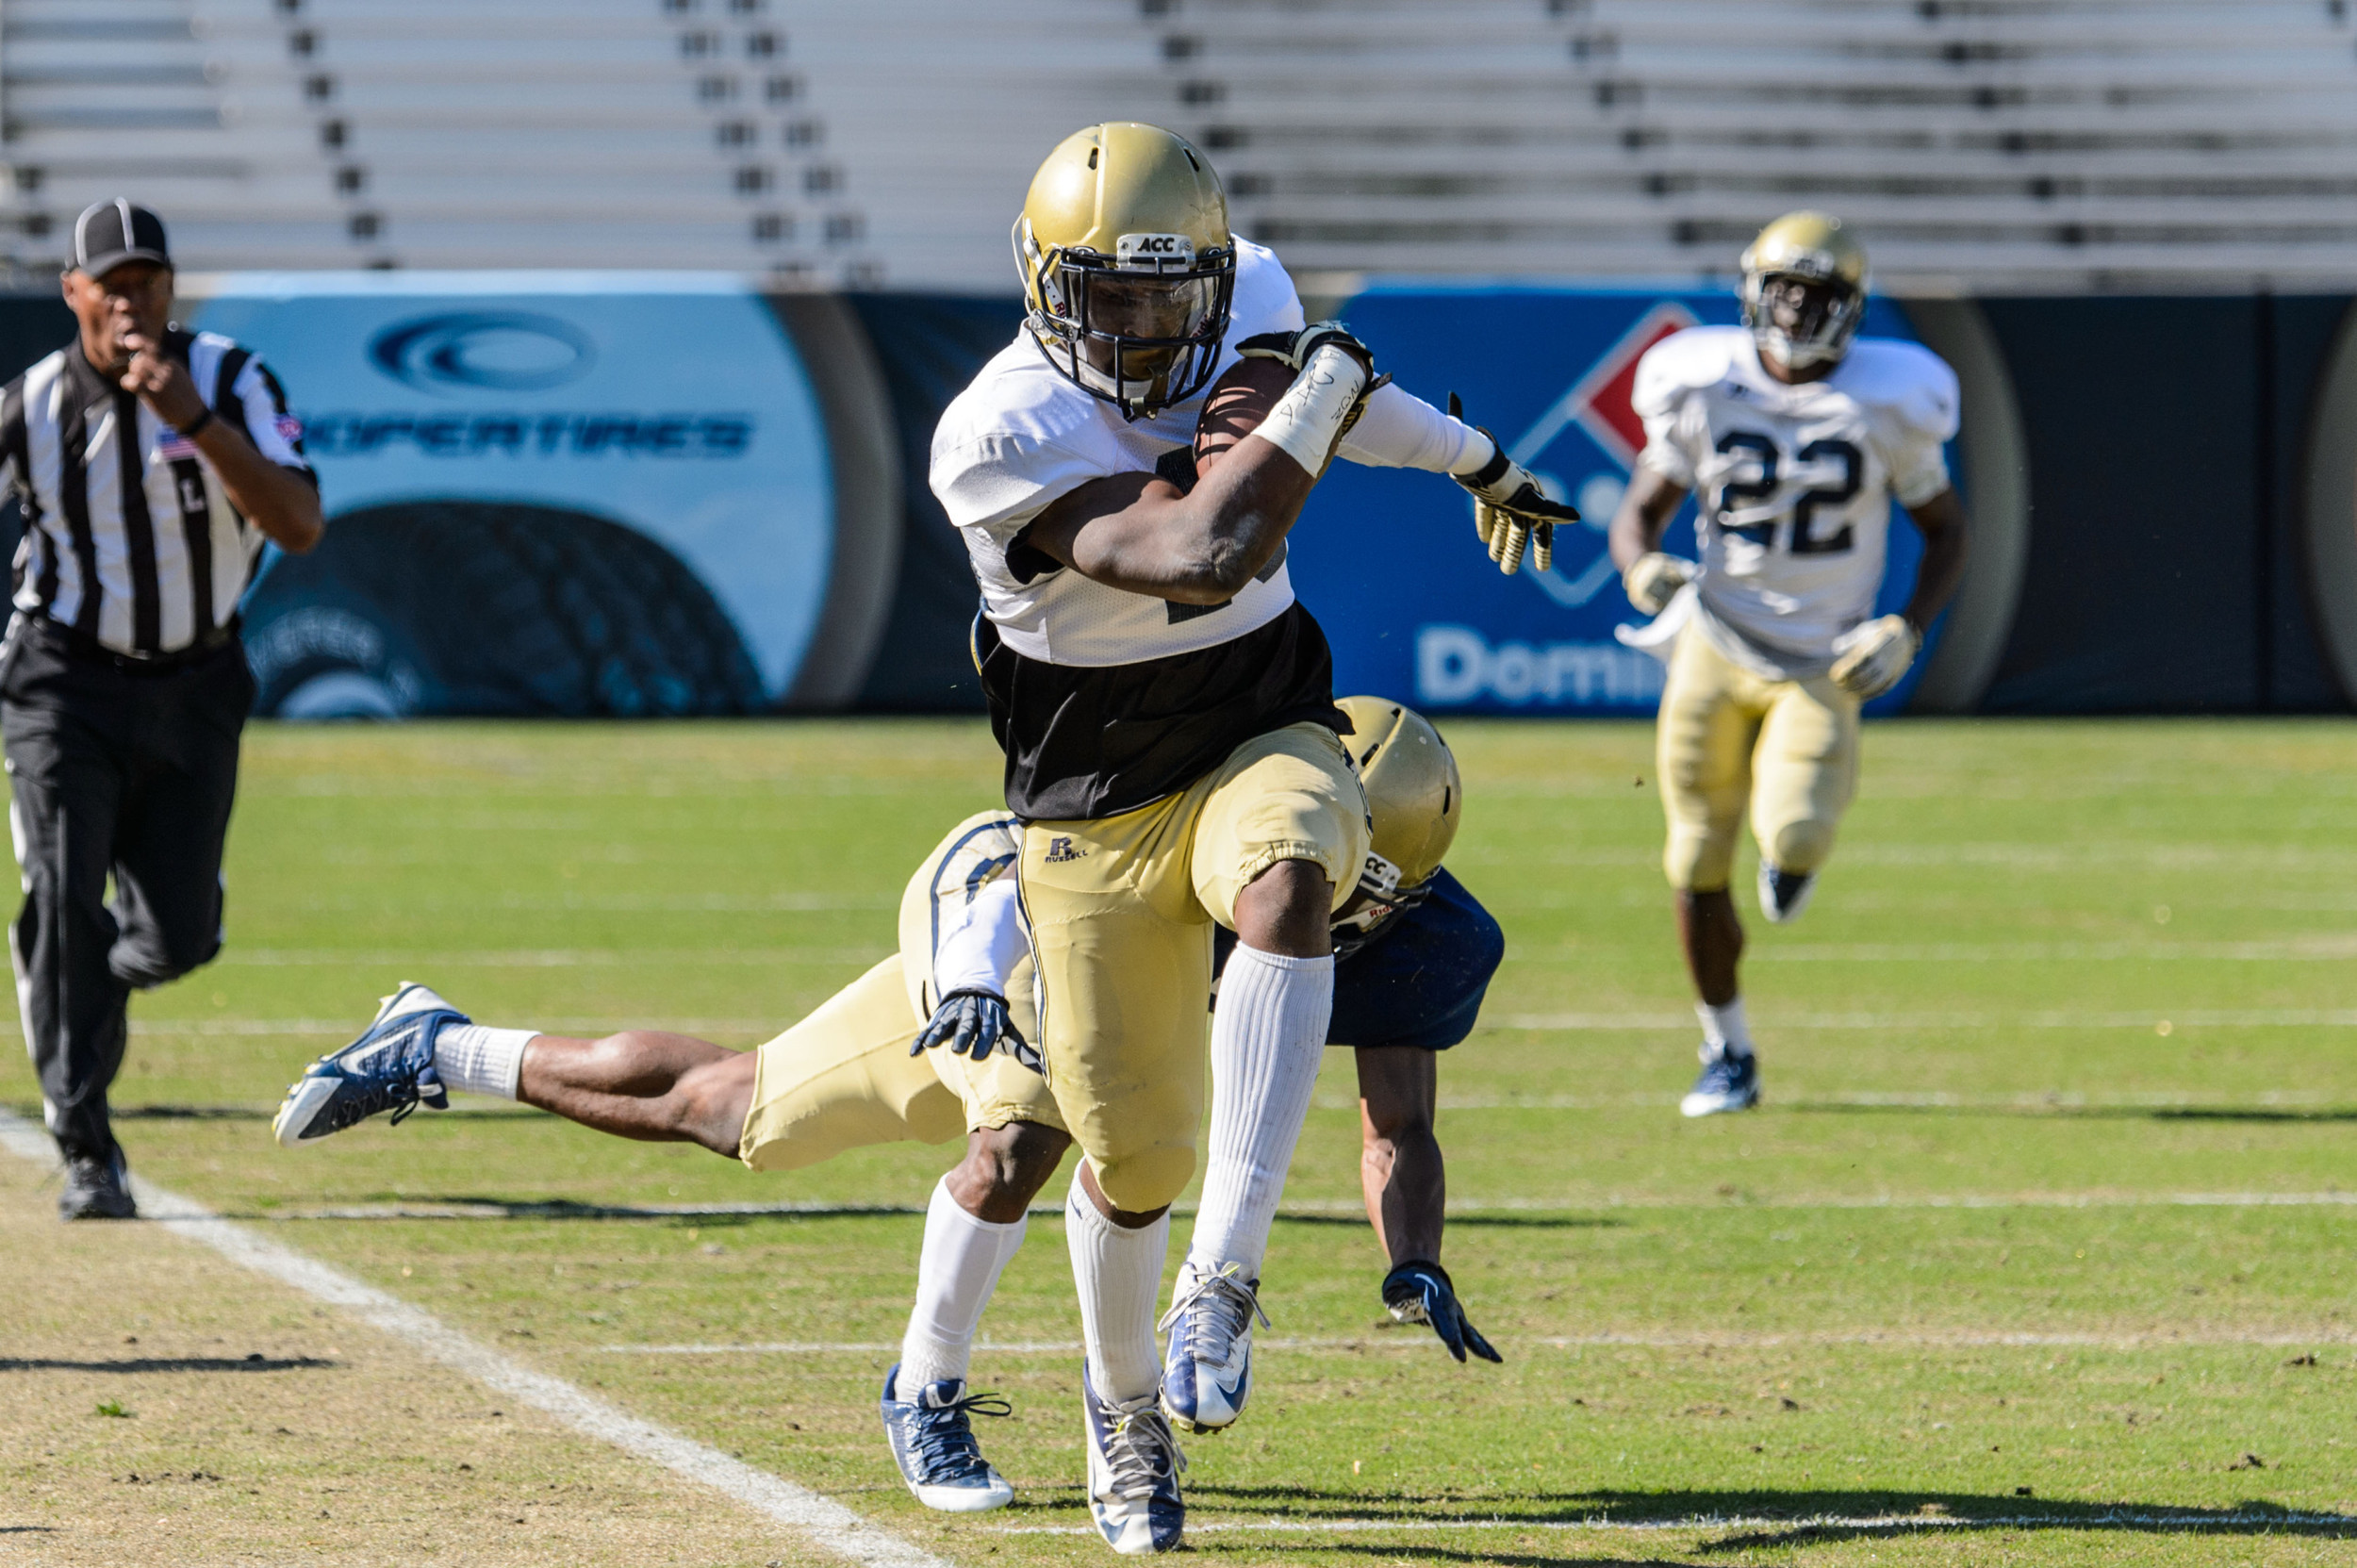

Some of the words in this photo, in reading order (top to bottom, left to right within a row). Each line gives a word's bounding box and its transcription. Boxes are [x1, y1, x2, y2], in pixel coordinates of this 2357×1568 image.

[1137, 237, 1175, 253] ACC
[180, 478, 205, 513] L
[1715, 432, 1864, 554] 22
[1416, 624, 1667, 701] Domi
[1364, 856, 1388, 875] CC
